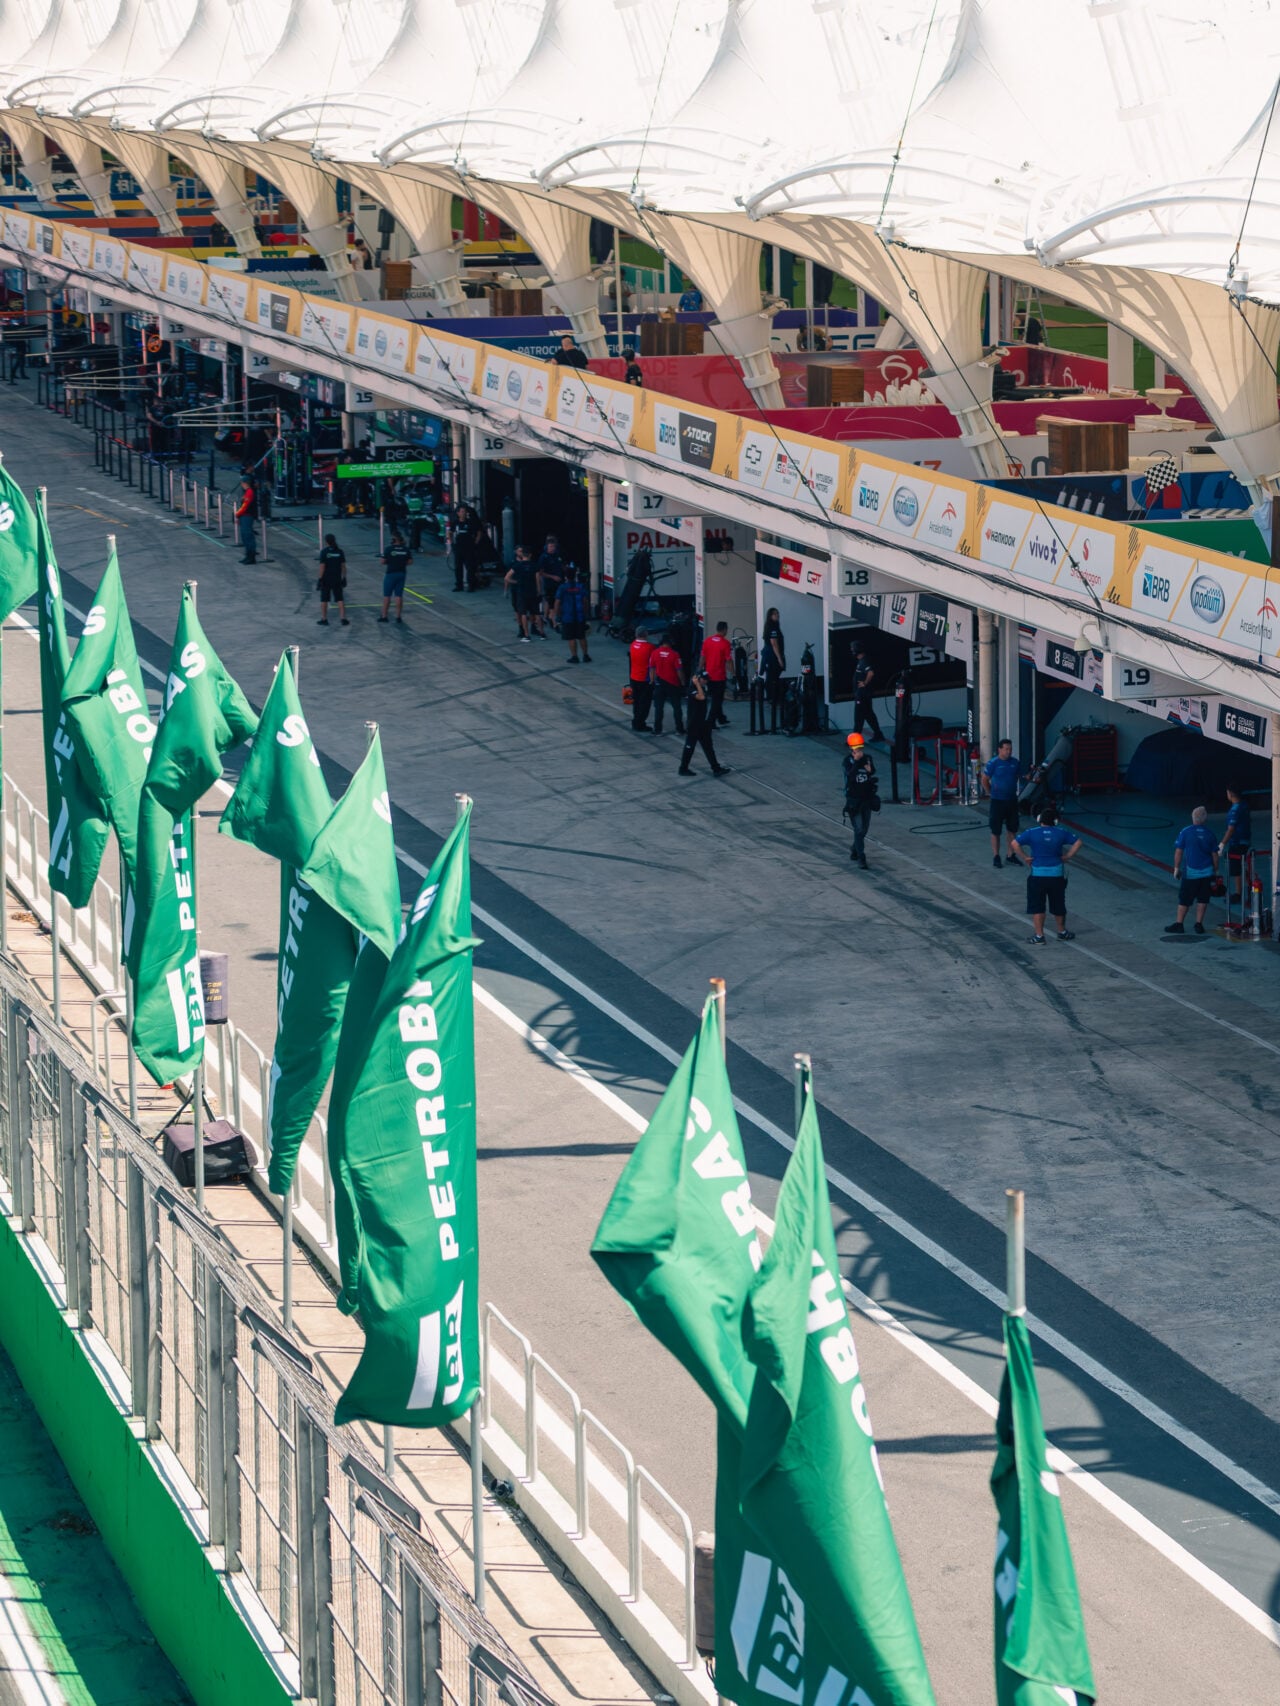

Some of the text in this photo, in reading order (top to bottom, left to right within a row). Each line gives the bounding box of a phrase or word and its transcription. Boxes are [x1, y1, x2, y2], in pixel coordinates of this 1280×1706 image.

[252, 356, 270, 366] 14
[355, 392, 373, 403] 15
[484, 438, 504, 450] 16
[643, 495, 664, 509] 17
[1028, 536, 1050, 561] vivo
[844, 569, 869, 586] 18
[1151, 575, 1171, 603] BRB
[934, 614, 946, 637] 77
[1123, 667, 1151, 686] 19
[1224, 711, 1237, 732] 66
